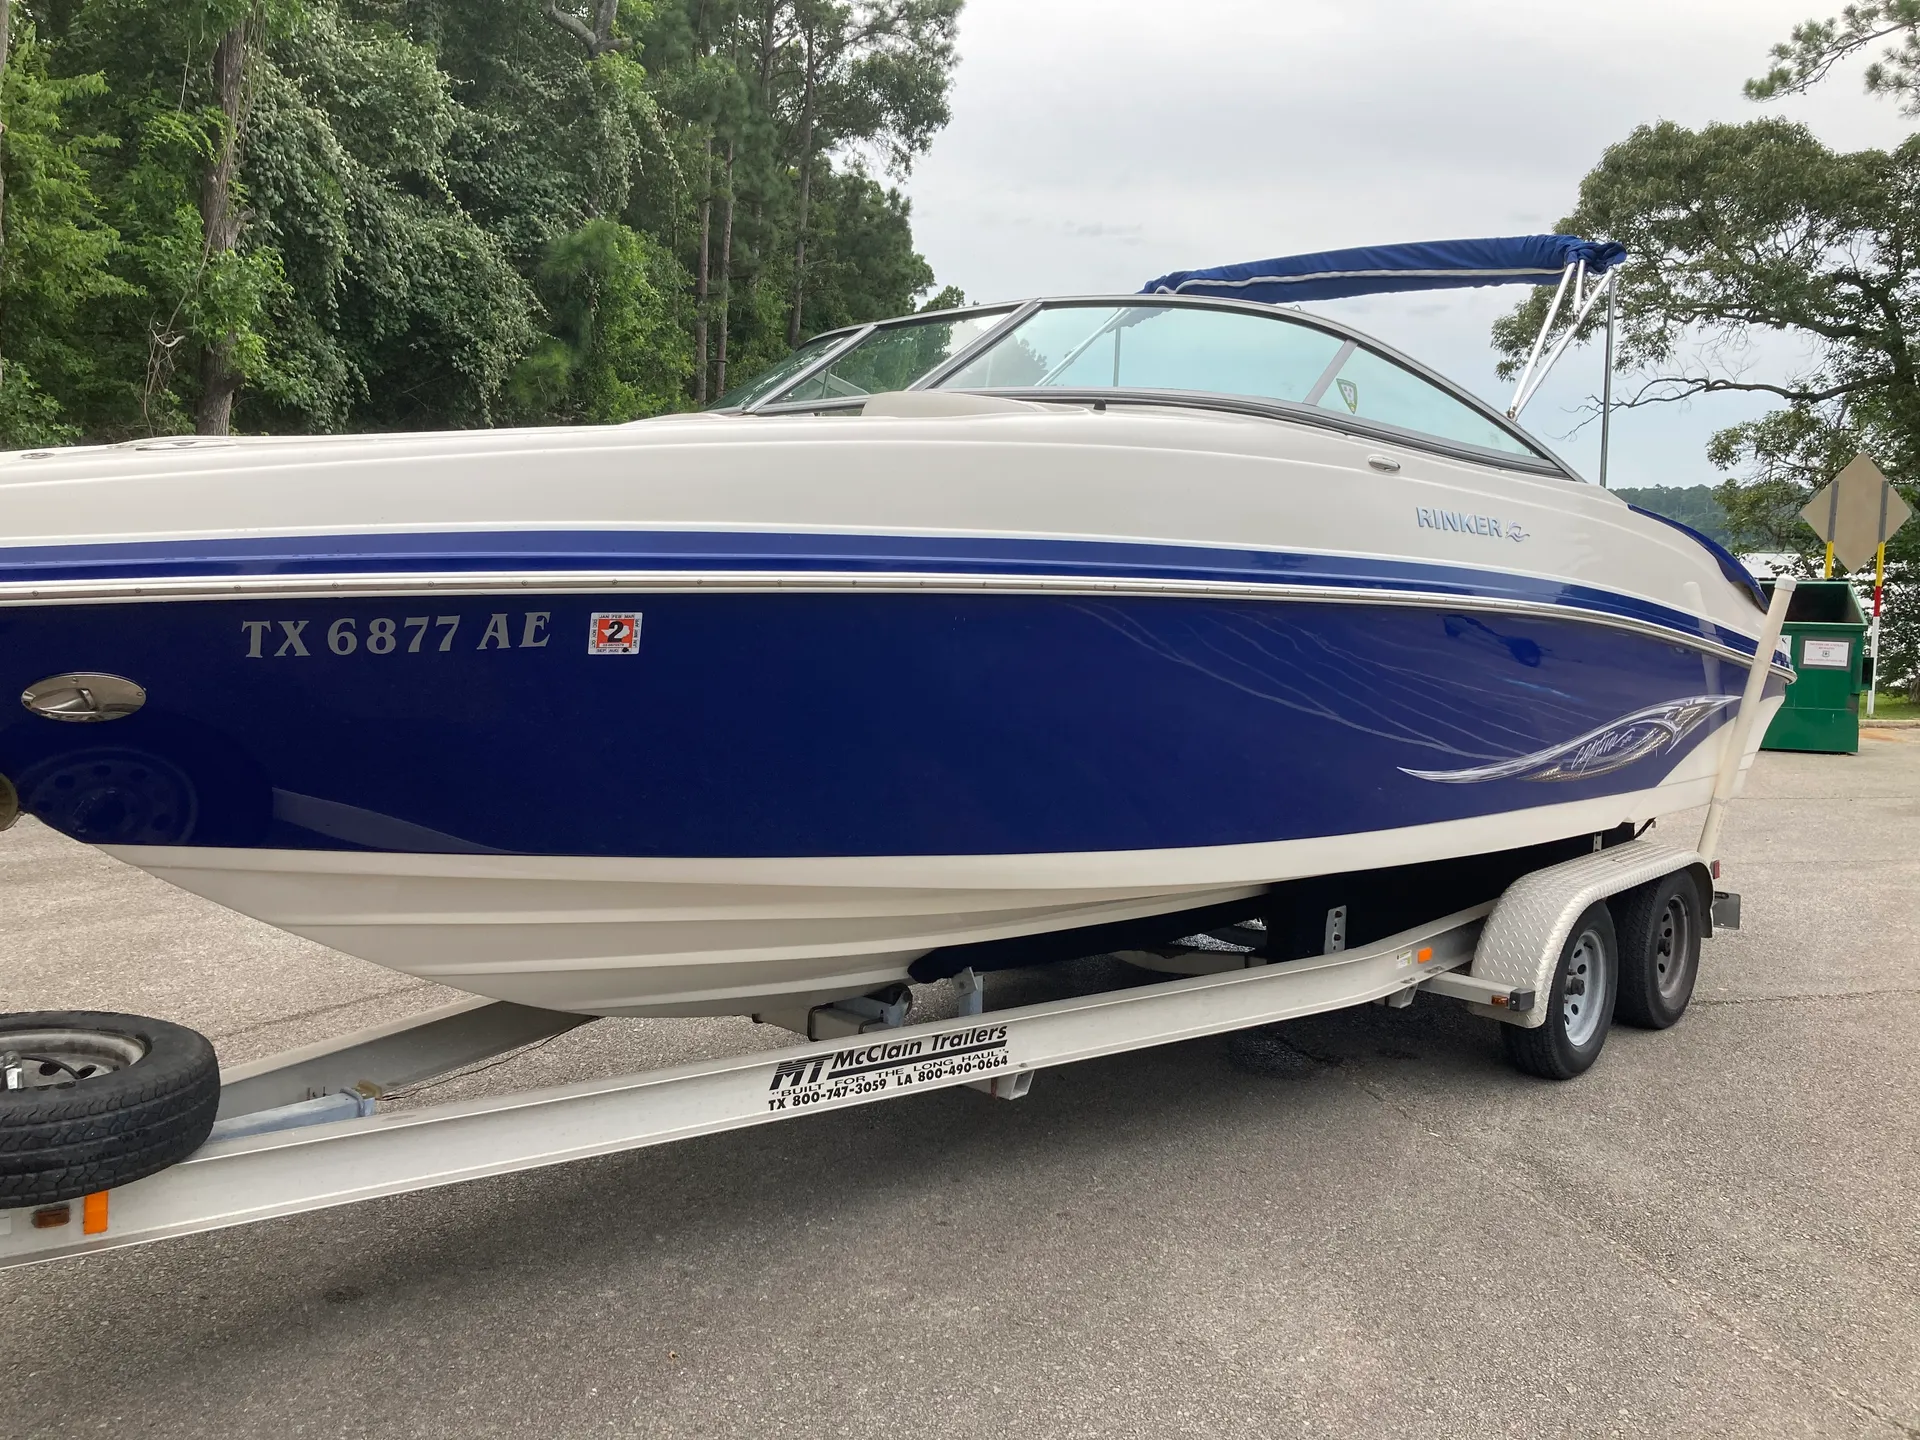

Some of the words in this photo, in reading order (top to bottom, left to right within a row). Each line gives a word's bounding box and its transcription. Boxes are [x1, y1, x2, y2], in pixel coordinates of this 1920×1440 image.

[1415, 506, 1503, 538] RINKER
[241, 620, 311, 658] TX
[327, 615, 461, 656] 6877
[476, 611, 551, 650] AE
[607, 621, 624, 643] 2
[831, 1040, 922, 1070] McClain
[931, 1025, 1008, 1051] Trailers
[768, 1097, 787, 1111] TX
[792, 1078, 887, 1107] 800-747-3059
[897, 1073, 913, 1086] LA
[917, 1054, 1008, 1083] 800-490-0664
[834, 1075, 866, 1087] FOR
[876, 1068, 904, 1079] THE
[913, 1058, 954, 1072] LONG
